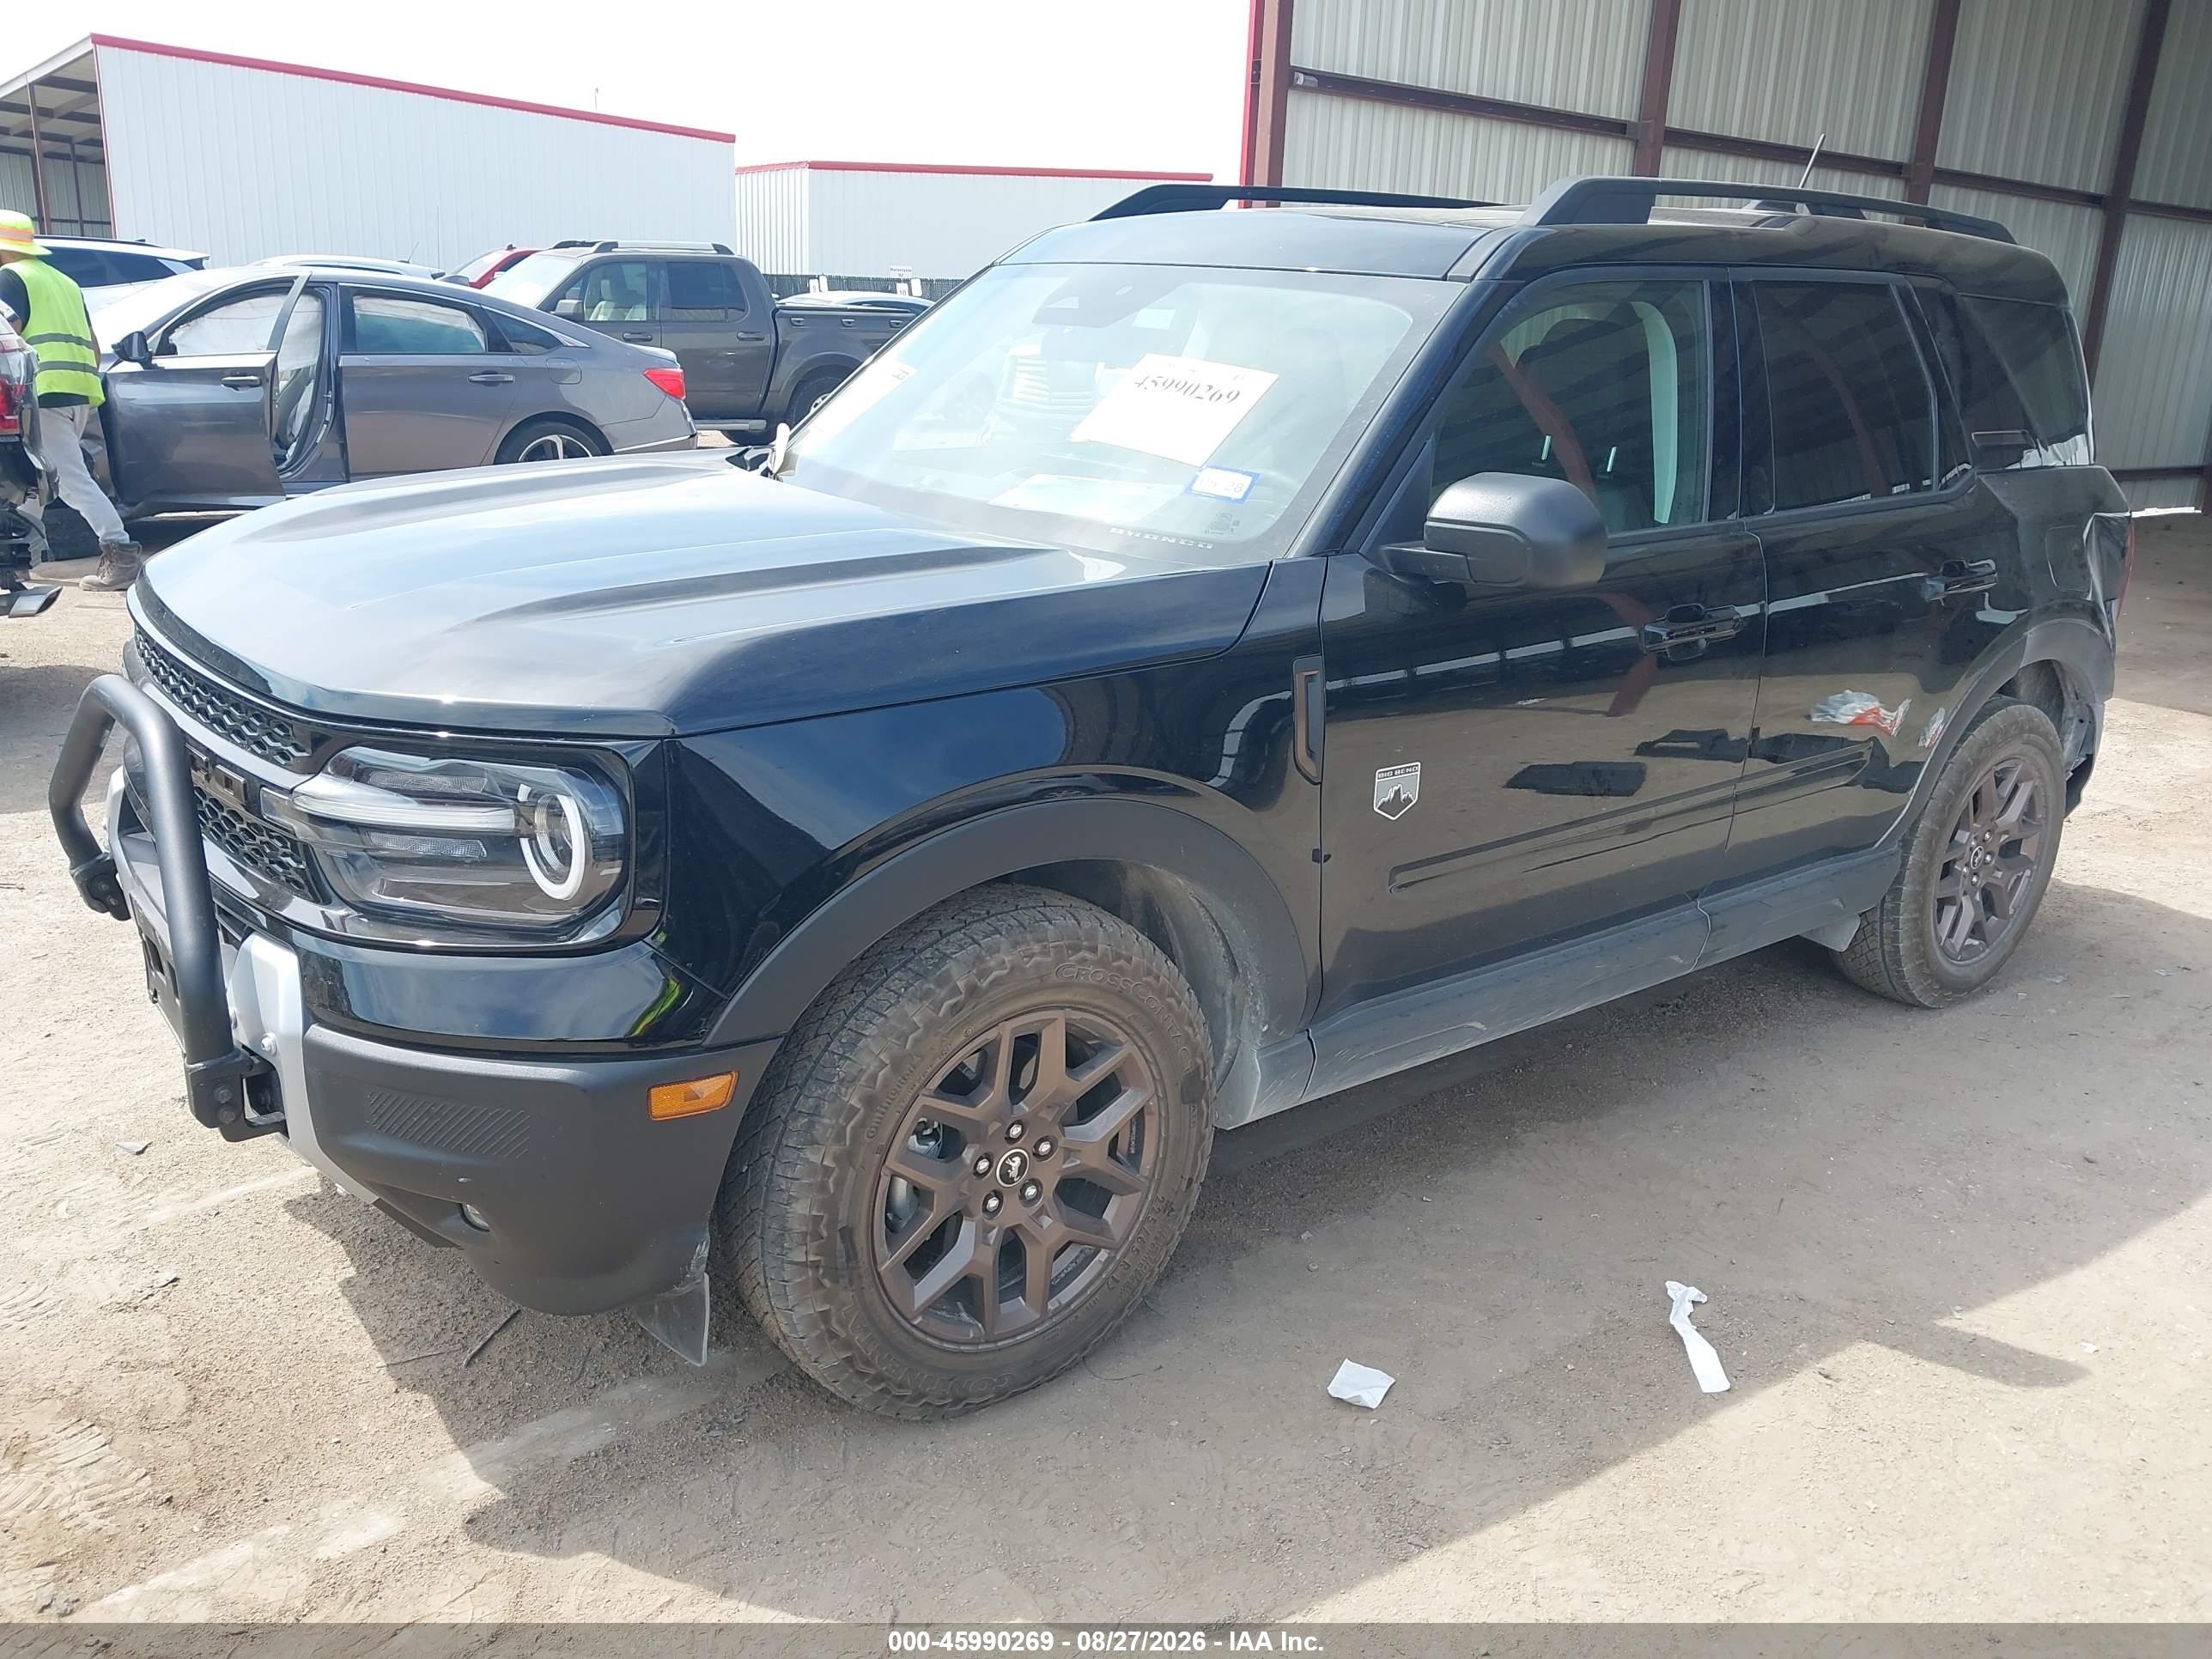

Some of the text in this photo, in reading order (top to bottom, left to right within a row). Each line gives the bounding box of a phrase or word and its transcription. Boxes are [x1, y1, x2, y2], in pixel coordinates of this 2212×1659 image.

[1133, 375, 1241, 404] 45990269
[1108, 526, 1215, 550] BRONCO
[1395, 766, 1419, 775] BEND
